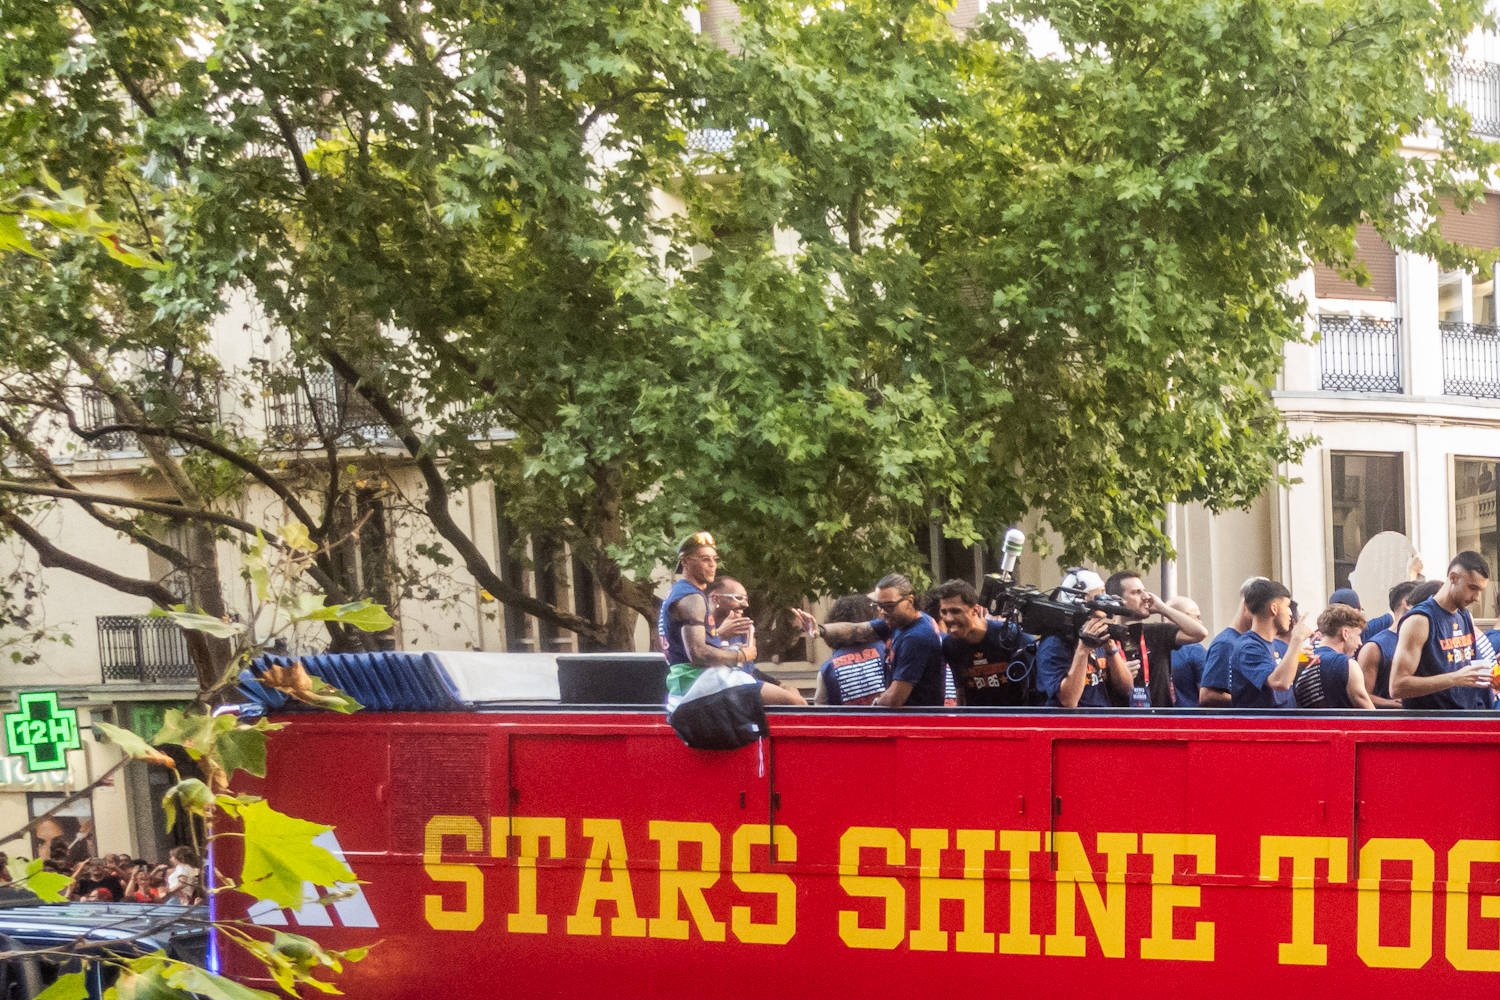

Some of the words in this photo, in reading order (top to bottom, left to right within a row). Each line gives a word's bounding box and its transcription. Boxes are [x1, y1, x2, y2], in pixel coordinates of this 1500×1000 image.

[16, 718, 72, 745] 12H
[424, 815, 797, 944] STARS
[839, 827, 1215, 961] SHINE
